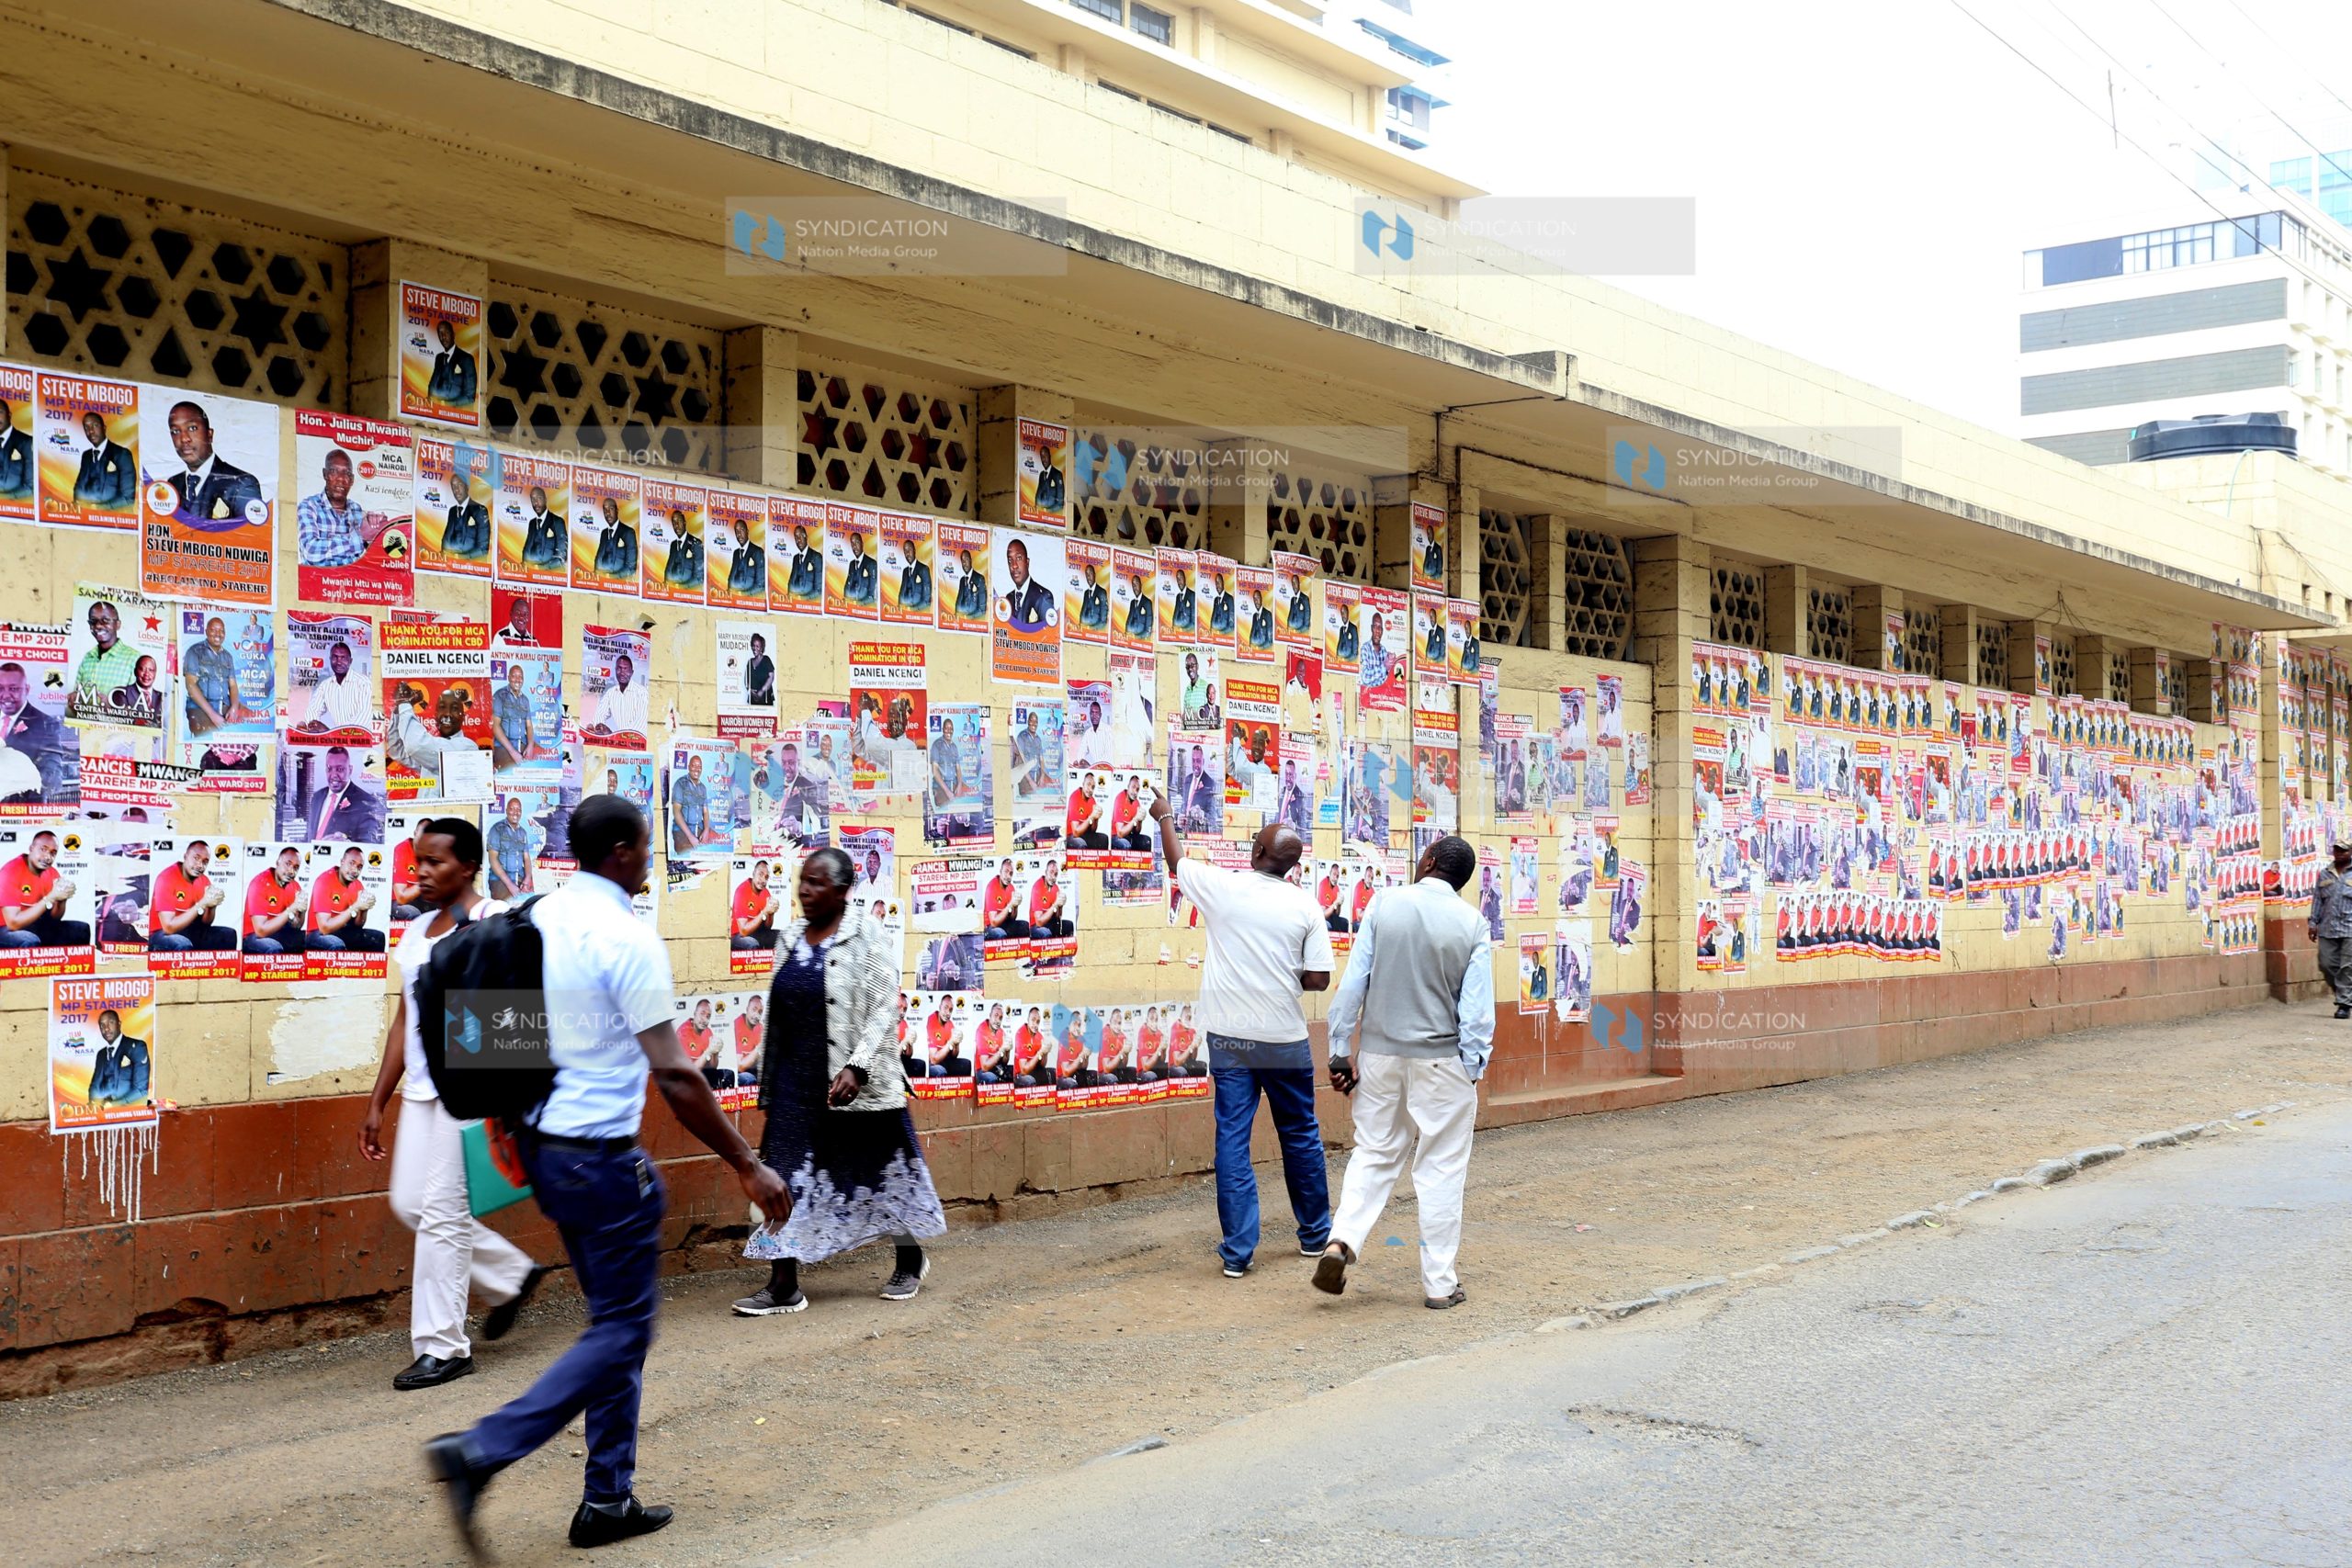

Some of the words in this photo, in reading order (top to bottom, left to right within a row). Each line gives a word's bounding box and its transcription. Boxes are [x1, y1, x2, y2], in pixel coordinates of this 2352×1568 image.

[407, 288, 438, 310] STEVE
[441, 296, 477, 317] MBOGO
[408, 316, 430, 327] 2017
[42, 378, 84, 400] STEVE
[87, 384, 133, 406] MBOGO
[69, 400, 123, 415] STAREHE
[46, 410, 73, 421] 2017
[330, 417, 363, 432] Julius
[1022, 422, 1041, 437] STEVE
[1042, 426, 1064, 442] MBOGO
[336, 433, 375, 446] Muchiri
[421, 443, 452, 460] STEVE
[381, 454, 403, 464] MCA
[379, 463, 407, 472] NAIROBI
[503, 457, 532, 475] STEVE
[535, 463, 567, 481] MBOGO
[422, 470, 443, 481] 2017
[576, 469, 605, 487] STEVE
[606, 475, 638, 493] MBOGO
[503, 484, 523, 494] 2017
[646, 482, 673, 499] STEVE
[675, 487, 704, 504] MBOGO
[577, 495, 596, 505] 2017
[710, 493, 736, 509] STEVE
[738, 498, 765, 514] MBOGO
[648, 508, 665, 518] 2017
[771, 501, 796, 516] STEVE
[797, 504, 823, 520] MBOGO
[829, 508, 853, 523] STEVE
[1415, 505, 1429, 517] STEVE
[712, 518, 729, 527] 2017
[882, 517, 904, 531] STEVE
[906, 520, 930, 534] MBOGO
[772, 524, 788, 533] 2017
[829, 530, 845, 539] 2017
[940, 527, 961, 540] STEVE
[963, 530, 986, 544] MBOGO
[883, 539, 898, 547] 2017
[147, 538, 179, 553] STEVE
[182, 541, 222, 558] MBOGO
[225, 547, 269, 563] NDWIGA
[942, 548, 956, 558] 2017
[1068, 542, 1086, 555] STEVE
[1088, 546, 1109, 560] MBOGO
[1115, 551, 1134, 564] STEVE
[1135, 555, 1155, 570] MBOGO
[1159, 550, 1177, 563] STEVE
[1199, 550, 1216, 564] STEVE
[1069, 562, 1081, 570] 2017
[1238, 569, 1254, 581] STEVE
[1255, 570, 1273, 583] MBOGO
[1327, 584, 1341, 596] STEVE
[1450, 603, 1464, 613] STEVE
[383, 626, 417, 635] THANK
[420, 626, 440, 635] YOU
[443, 626, 462, 635] FOR
[465, 627, 485, 636] MCA
[14, 634, 32, 644] MP
[36, 635, 65, 646] 2017
[387, 637, 449, 646] NOMINATION
[453, 637, 462, 646] IN
[465, 638, 483, 647] CBD
[1013, 639, 1035, 650] MBOGO
[720, 641, 749, 650] MUDACHI
[26, 650, 64, 660] CHOICE
[387, 653, 433, 664] DANIEL
[437, 653, 484, 664] NGENGI
[854, 654, 897, 662] NOMINATION
[241, 670, 266, 679] MCA
[299, 670, 319, 678] MCA
[854, 668, 886, 677] DANIEL
[1228, 682, 1245, 691] THANK
[1228, 702, 1251, 711] DANIEL
[107, 708, 128, 716] WARD
[536, 712, 556, 720] MCA
[720, 717, 743, 727] NAIROBI
[743, 718, 764, 727] WOMEN
[1416, 730, 1435, 739] DANIEL
[695, 744, 714, 752] KAMAU
[81, 775, 136, 787] STAREHE
[140, 780, 157, 788] MP
[217, 779, 243, 789] WARD
[1, 806, 28, 815] FRESH
[948, 860, 982, 871] MWANGI
[919, 873, 949, 882] STAREHE
[32, 946, 65, 958] NJAGUA
[67, 945, 92, 955] KANYI
[150, 953, 183, 962] CHARLES
[185, 952, 214, 961] NJAGUA
[216, 951, 239, 960] KANYI
[243, 955, 274, 964] CHARLES
[307, 952, 336, 960] CHARLES
[338, 953, 364, 962] NJAGUA
[366, 953, 386, 962] KANYI
[16, 964, 62, 976] STAREHE
[64, 964, 90, 973] 2017
[169, 968, 209, 977] STAREHE
[212, 968, 236, 976] 2017
[262, 971, 300, 979] STAREHE
[323, 968, 360, 976] STAREHE
[59, 983, 100, 1001] STEVE
[105, 981, 149, 998] MBOGO
[61, 1002, 80, 1011] MP
[85, 999, 140, 1010] STAREHE
[61, 1013, 88, 1023] 2017
